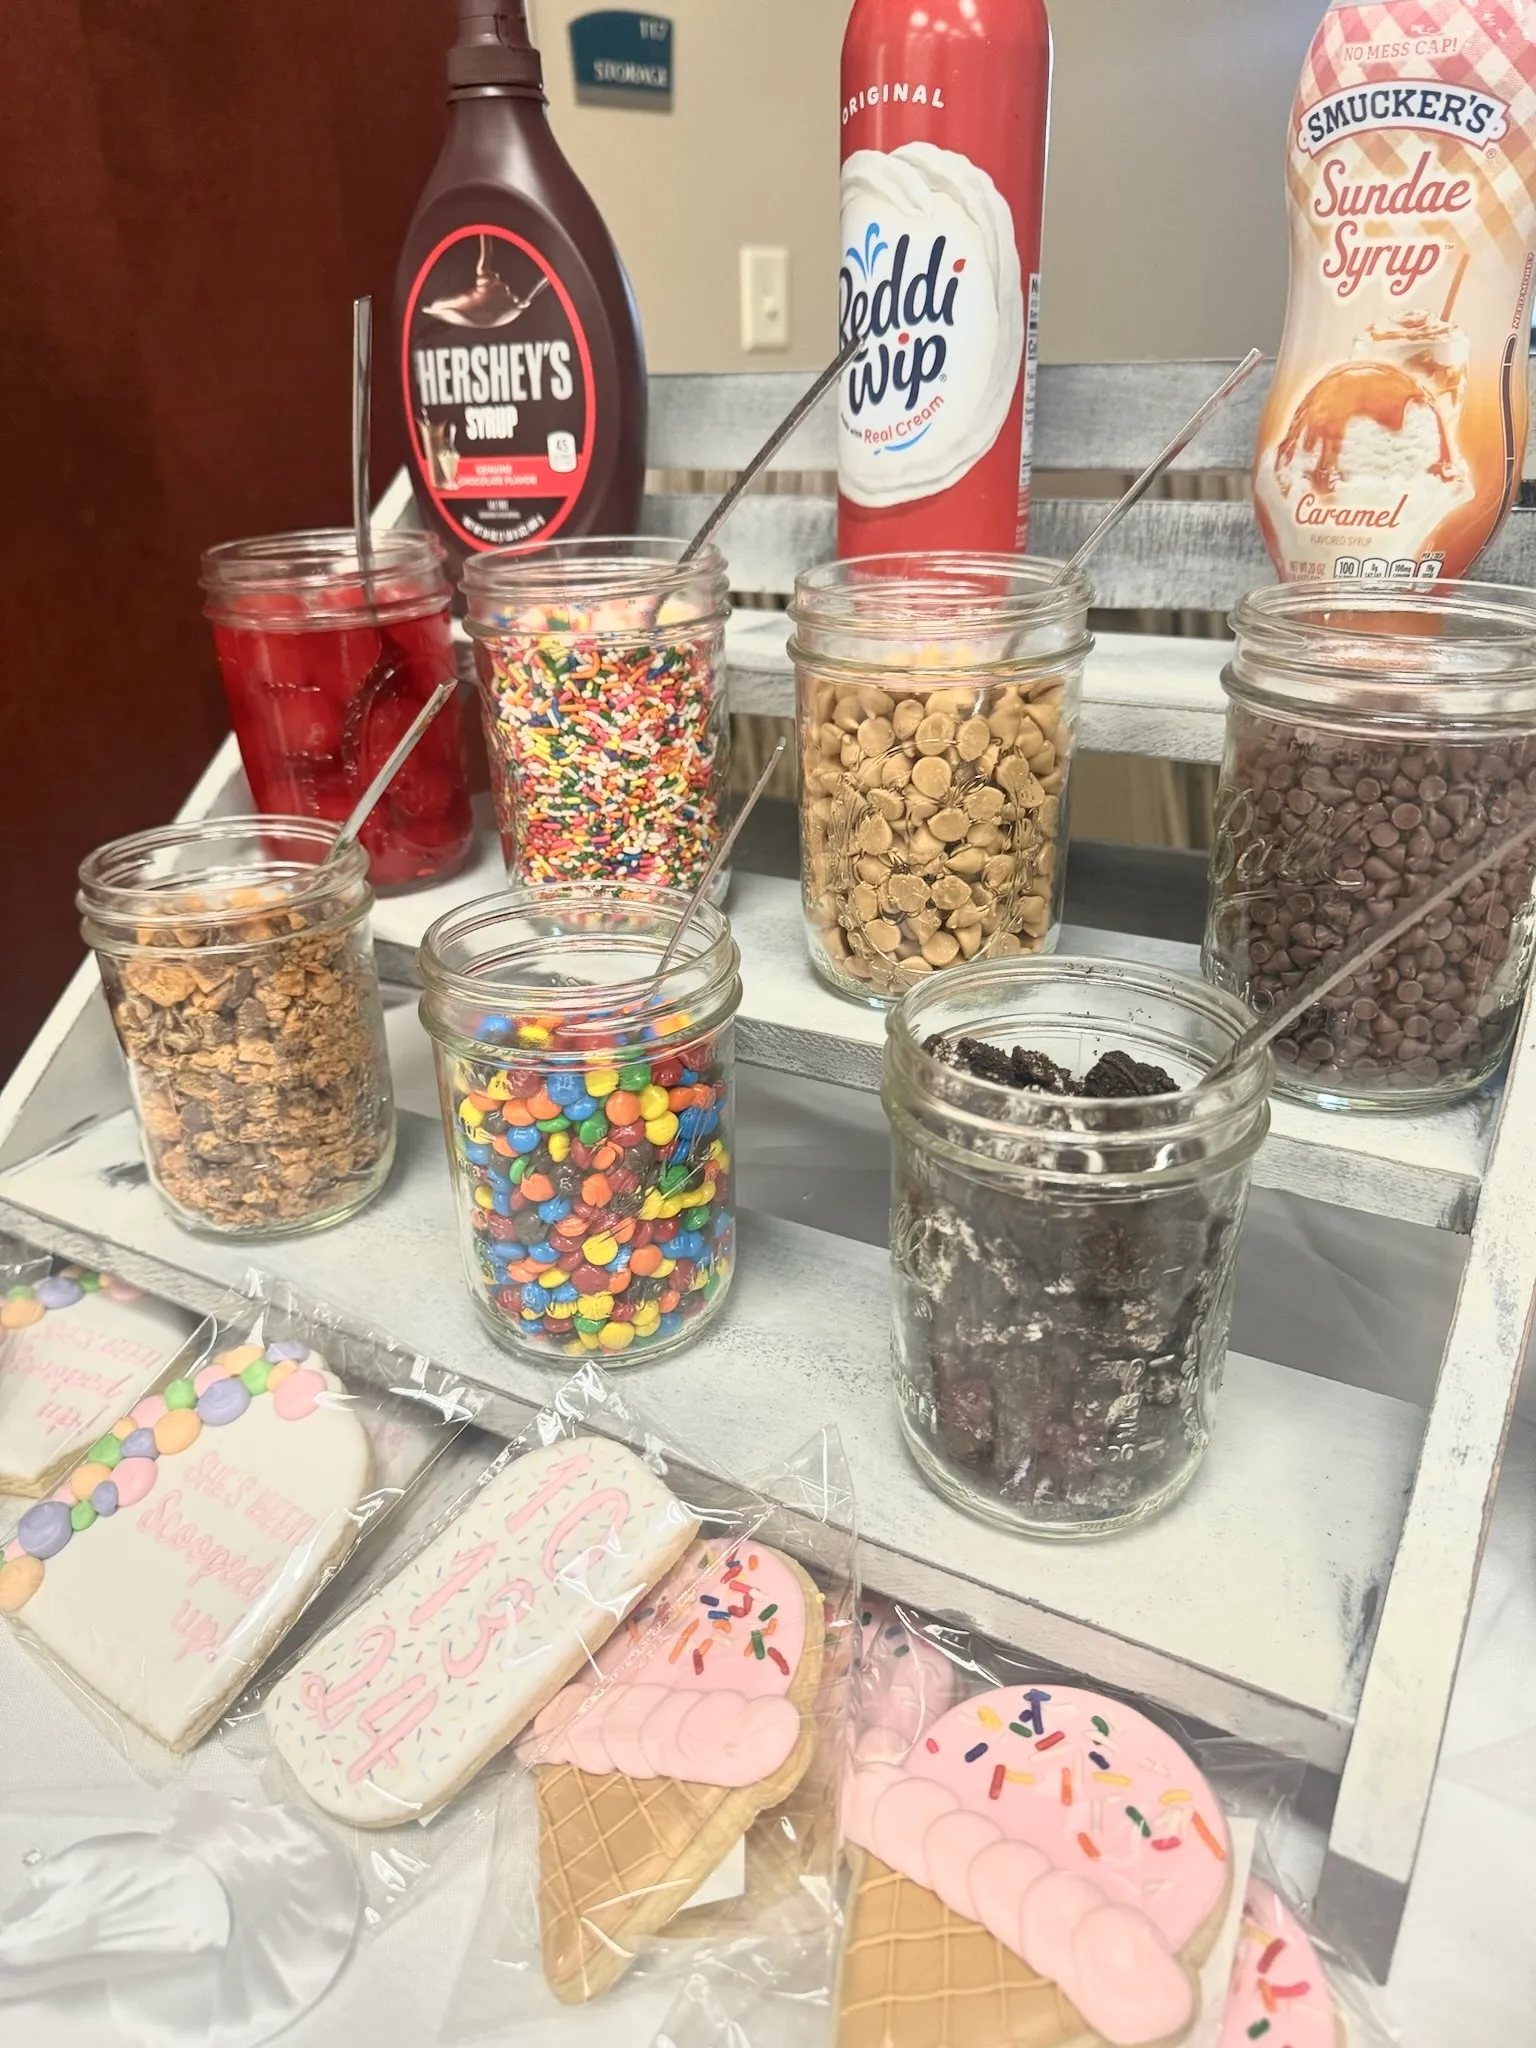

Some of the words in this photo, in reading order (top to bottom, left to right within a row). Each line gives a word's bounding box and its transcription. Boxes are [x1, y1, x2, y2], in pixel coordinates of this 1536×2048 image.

[1343, 47, 1363, 61] NO
[1366, 42, 1410, 60] MESS
[1415, 37, 1458, 56] CAP!
[841, 82, 945, 125] ORIGINAL
[1307, 89, 1495, 143] SMUCKER'S
[1314, 150, 1472, 218] Sundae
[1322, 220, 1441, 298] Syrup
[416, 340, 574, 406] HERSHEY'S
[464, 405, 518, 441] SYRUP
[863, 424, 893, 446] Real
[895, 395, 945, 437] Cream
[1295, 492, 1409, 529] Caramel
[1310, 535, 1346, 546] FLAVORED
[1349, 536, 1373, 547] SYRUP
[1340, 561, 1355, 575] 100
[136, 1487, 285, 1604] Scooped
